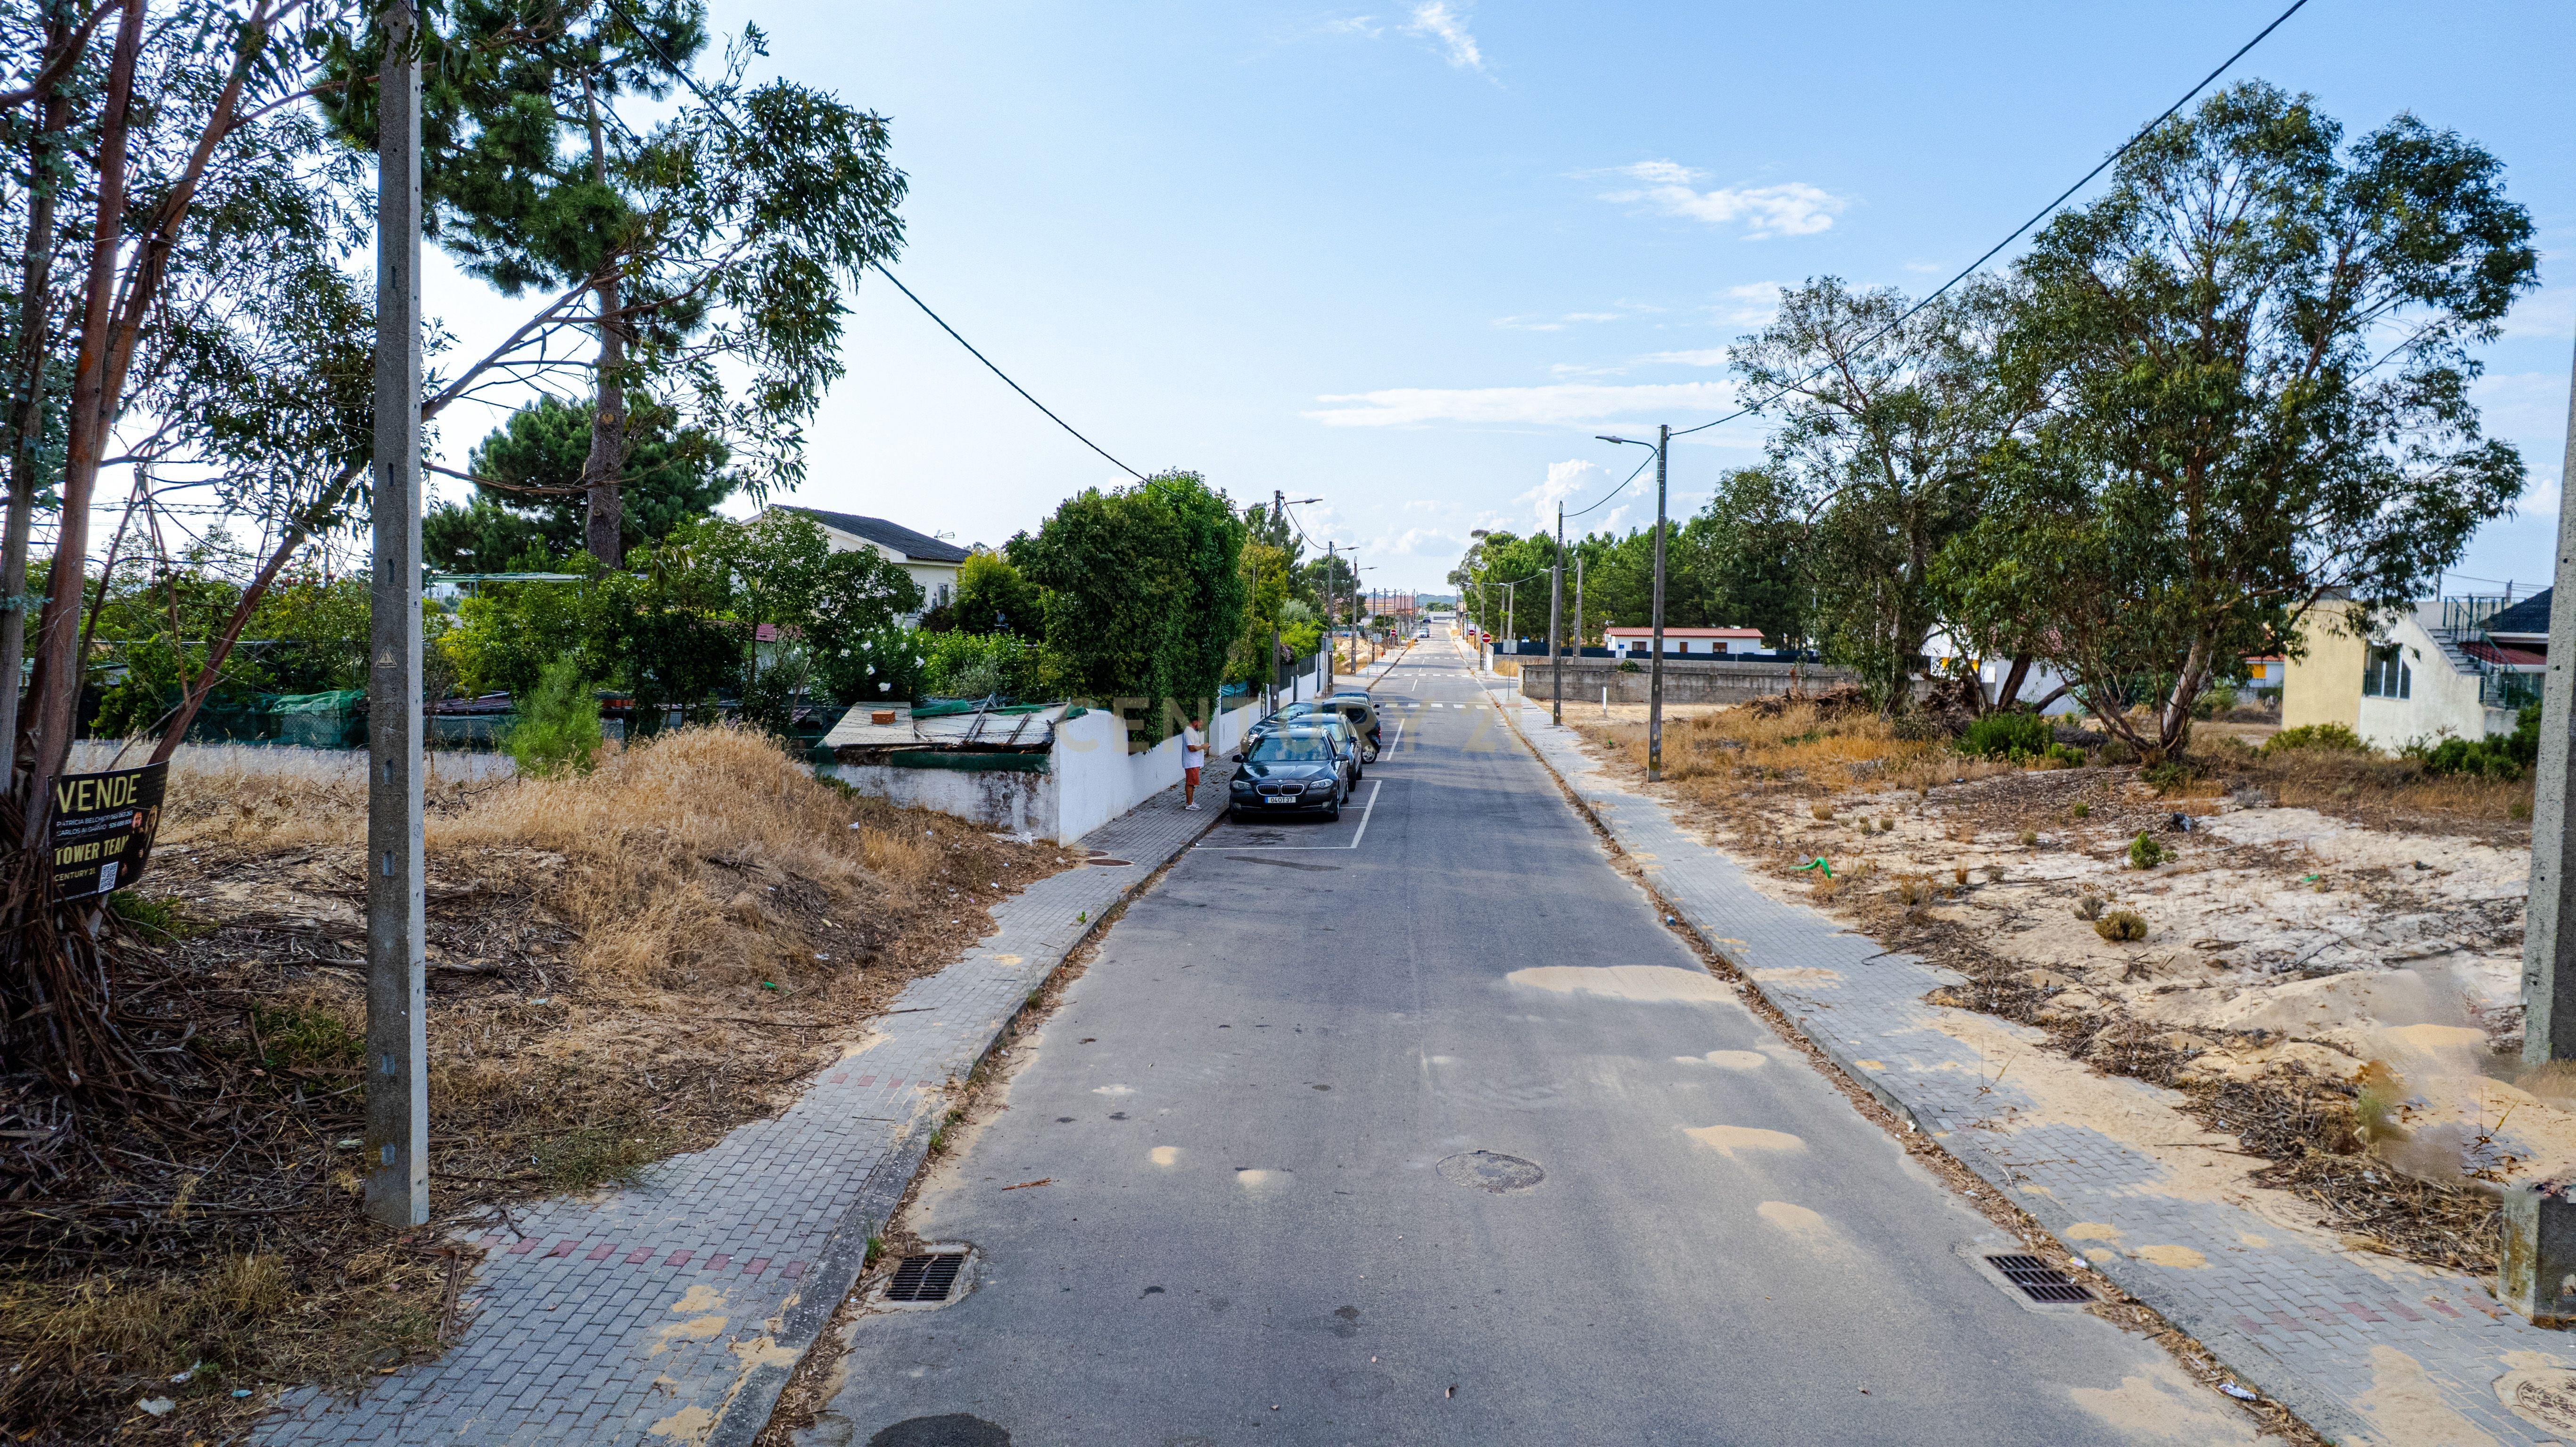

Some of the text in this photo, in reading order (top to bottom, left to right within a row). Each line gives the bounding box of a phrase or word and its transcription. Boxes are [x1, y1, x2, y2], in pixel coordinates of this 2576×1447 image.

[57, 773, 141, 813] VENDE
[56, 828, 81, 836] CARLOS
[54, 842, 100, 866] TOWER
[54, 867, 96, 882] CENTURY 21
